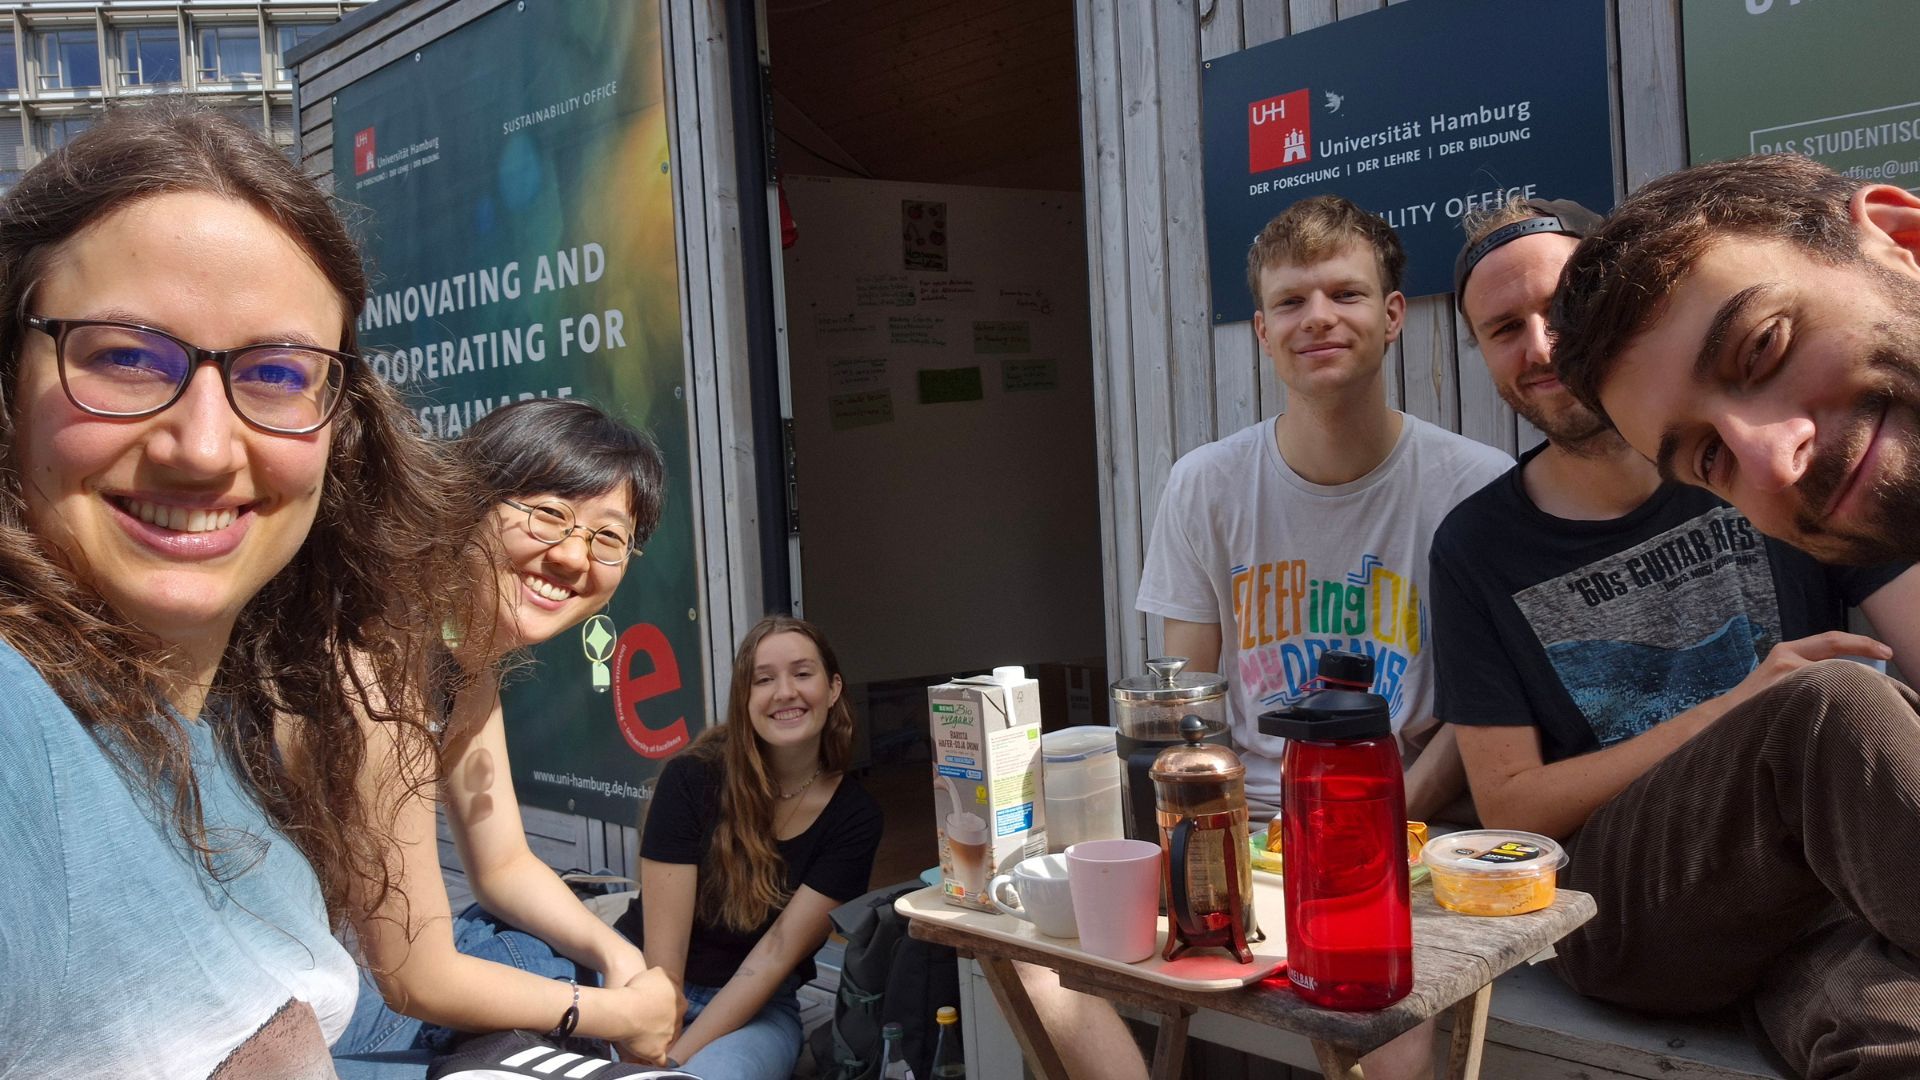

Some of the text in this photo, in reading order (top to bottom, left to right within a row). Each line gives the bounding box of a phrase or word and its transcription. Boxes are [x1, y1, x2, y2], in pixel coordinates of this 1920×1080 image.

[503, 81, 617, 135] SUSTAINABILITY OFFICE
[1319, 101, 1531, 158] Universität Hamburg
[377, 136, 439, 168] Universität Hamburg
[1249, 127, 1531, 196] DER FORSCHUNG DER LEHRE DER BILDUNG
[533, 242, 605, 295] AND
[560, 309, 627, 356] FOR
[1625, 529, 1712, 589] GUITAR
[1239, 648, 1283, 695] MY
